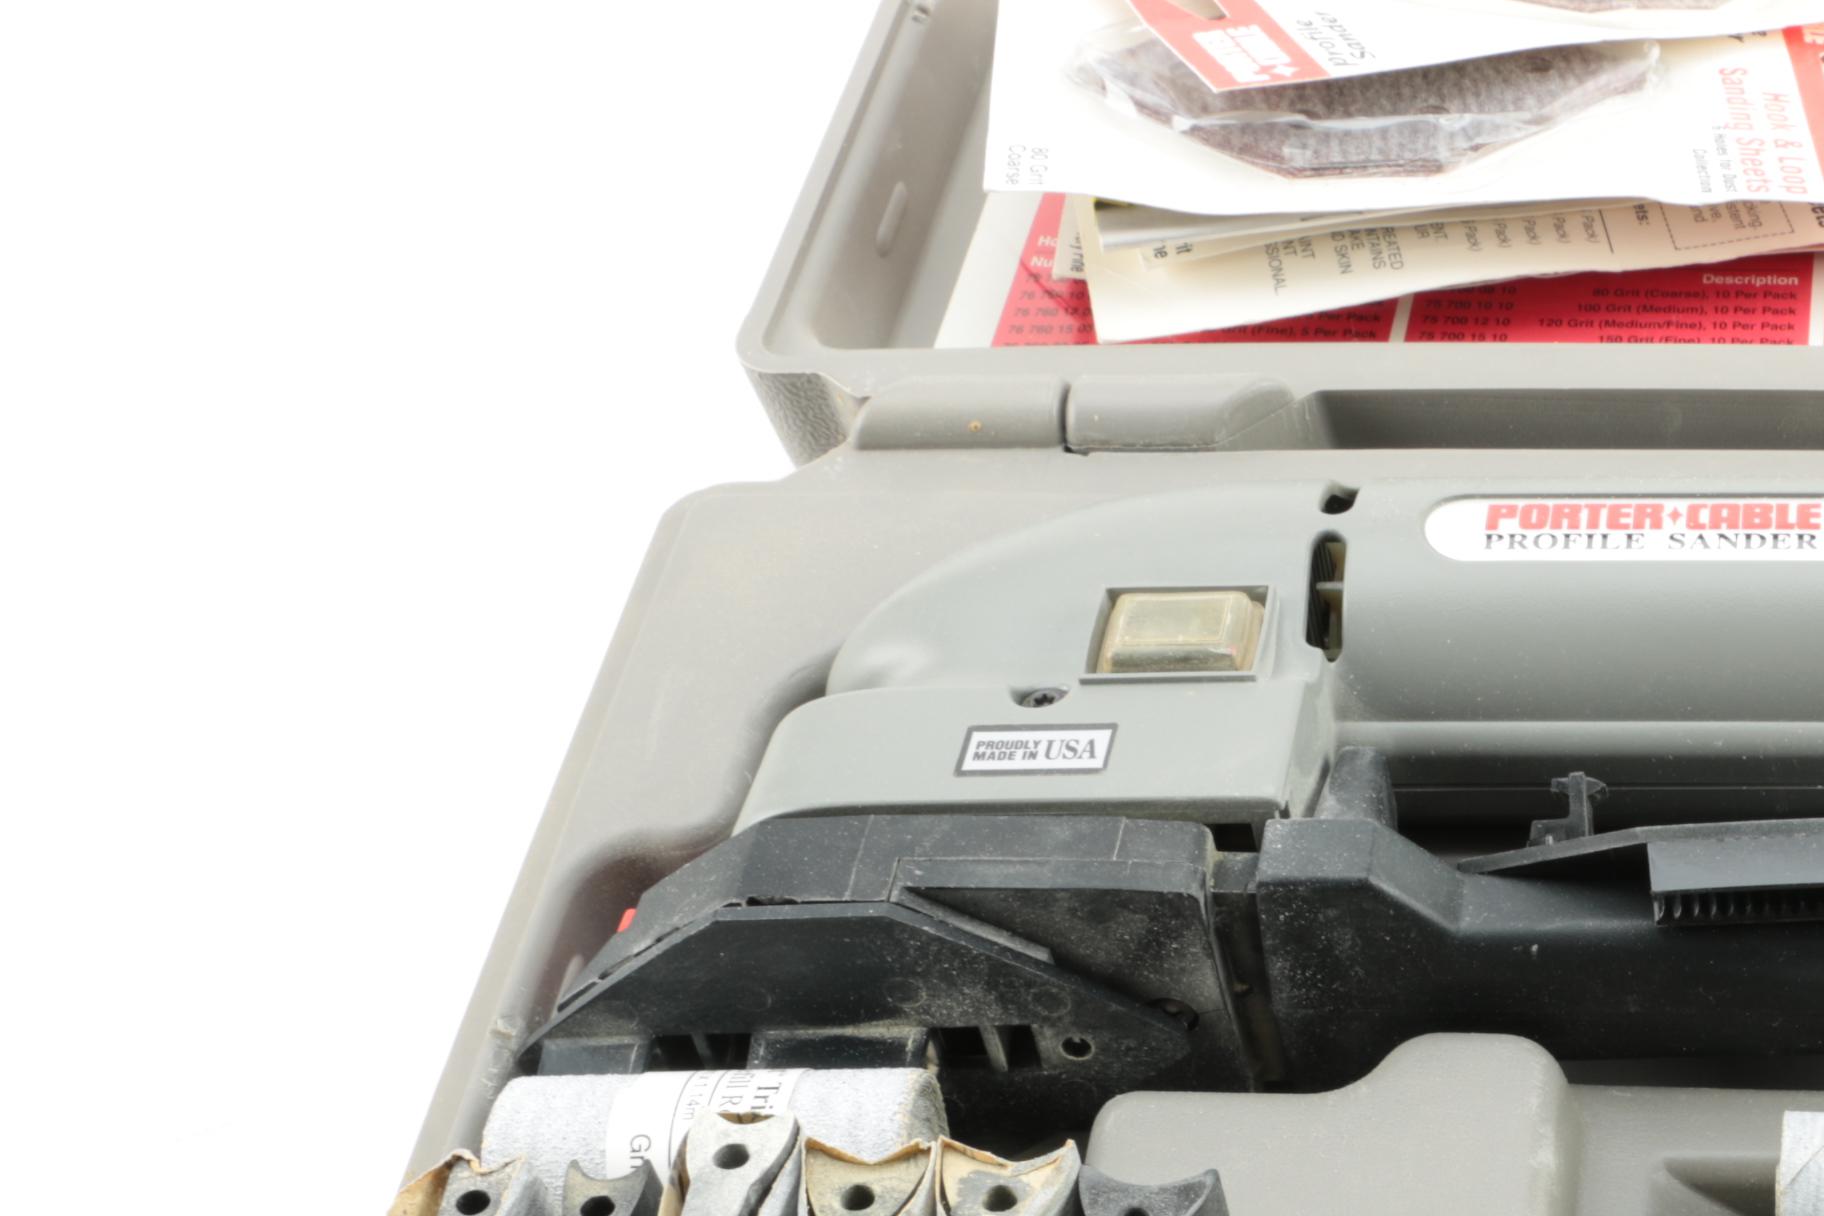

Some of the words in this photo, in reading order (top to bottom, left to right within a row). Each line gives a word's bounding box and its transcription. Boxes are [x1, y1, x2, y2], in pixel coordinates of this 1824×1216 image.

[1718, 68, 1757, 130] Sanding
[1762, 92, 1797, 131] Hook
[1774, 138, 1803, 148] &
[1031, 147, 1048, 160] 80
[1006, 145, 1026, 185] Coarse
[1736, 137, 1773, 192] Sheets
[1777, 156, 1808, 194] Loop
[1334, 245, 1353, 275] SKIN
[1702, 273, 1799, 286] Description
[1763, 290, 1797, 300] Pack
[1606, 304, 1632, 313] Grit
[1636, 304, 1708, 315] (Medium),
[1713, 305, 1729, 314] 10
[1733, 305, 1757, 315] Per
[1762, 306, 1796, 316] Pack
[1567, 319, 1594, 328] Grit
[1711, 321, 1728, 330] 10
[1732, 321, 1757, 331] Per
[1760, 322, 1795, 331] Pack
[1485, 504, 1668, 531] PORTER
[1689, 504, 1821, 531] CABLE
[1484, 532, 1645, 551] PROFILE
[1668, 532, 1818, 551] SANDER
[975, 740, 1041, 751] PROUDLY
[1045, 738, 1097, 760] USA
[972, 751, 1017, 762] MADE
[1022, 751, 1038, 761] IN
